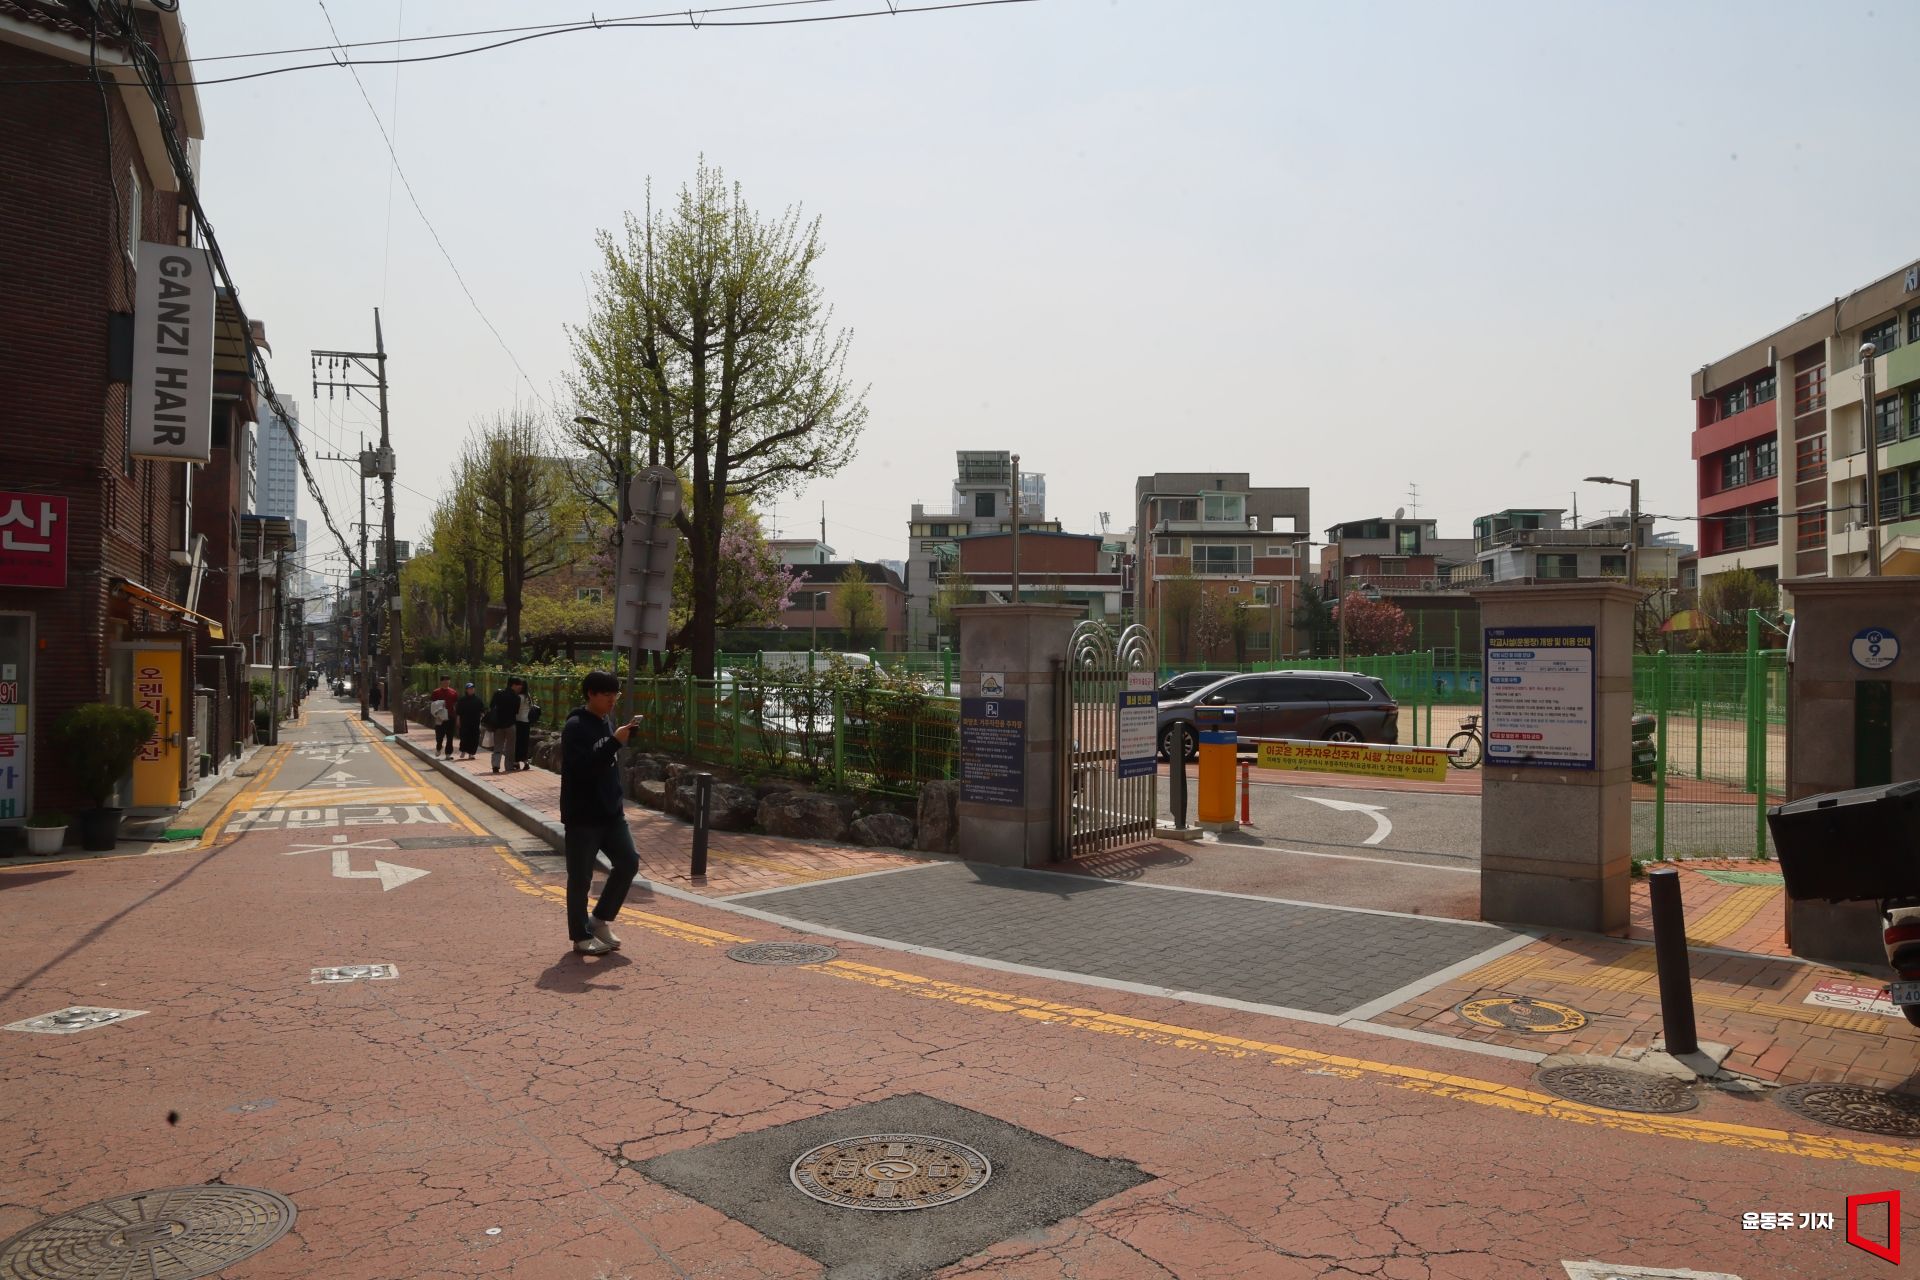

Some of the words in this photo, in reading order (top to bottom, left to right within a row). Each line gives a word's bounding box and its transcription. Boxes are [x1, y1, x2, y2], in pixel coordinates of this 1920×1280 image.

[157, 255, 192, 356] GANZI
[153, 367, 188, 446] HAIR
[1266, 745, 1292, 757] 이곳은
[1296, 747, 1360, 761] 거주자우선주차
[1363, 751, 1382, 762] 시행
[1385, 753, 1438, 767] 지역입니다.
[224, 806, 455, 834] 진입금지
